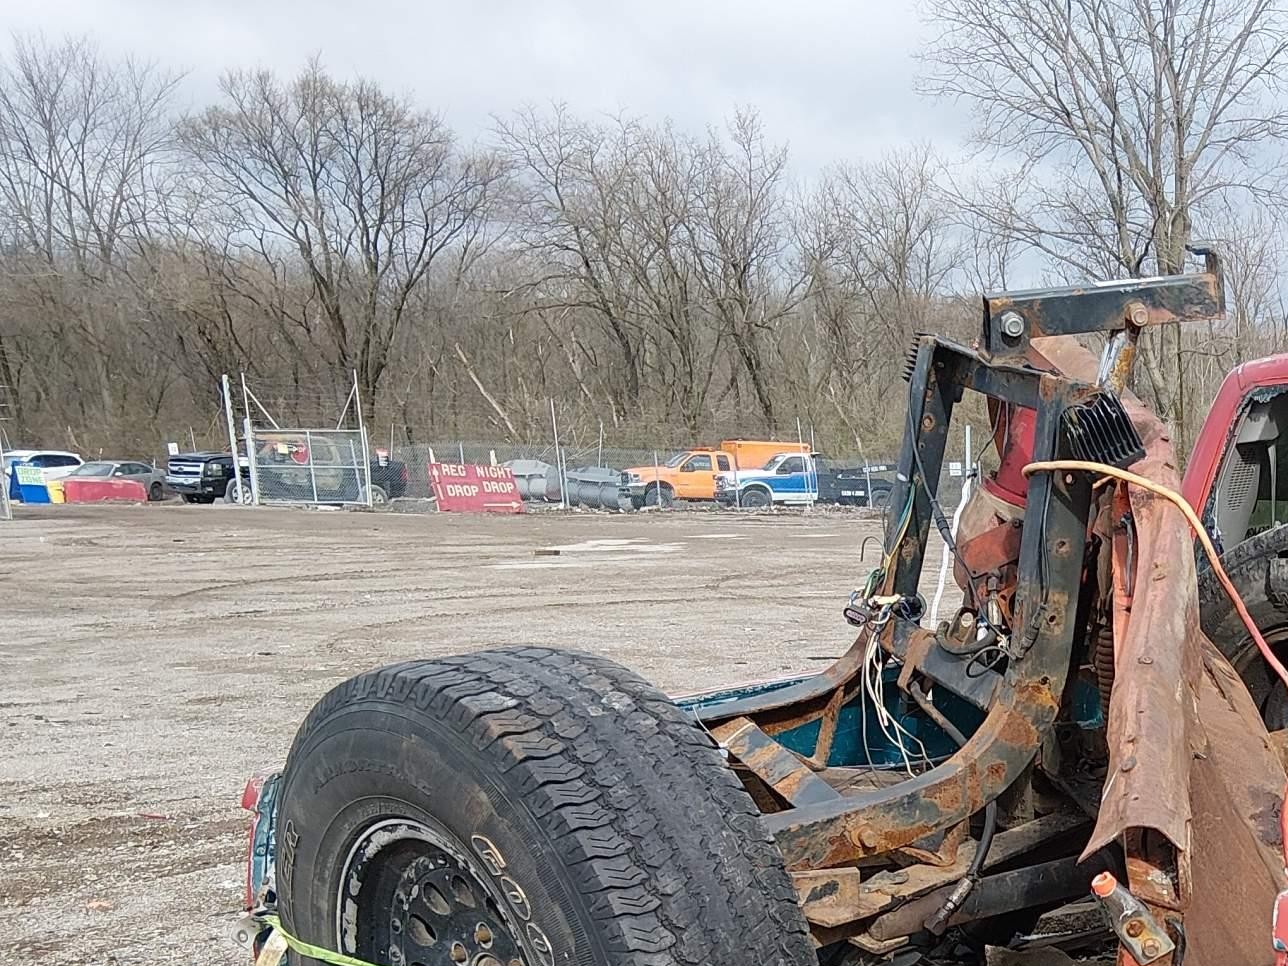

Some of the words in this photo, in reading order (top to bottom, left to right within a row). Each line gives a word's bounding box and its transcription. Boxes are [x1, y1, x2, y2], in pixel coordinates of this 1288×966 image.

[476, 466, 512, 479] NIGHT
[446, 484, 479, 497] DROP
[482, 481, 515, 494] DROP
